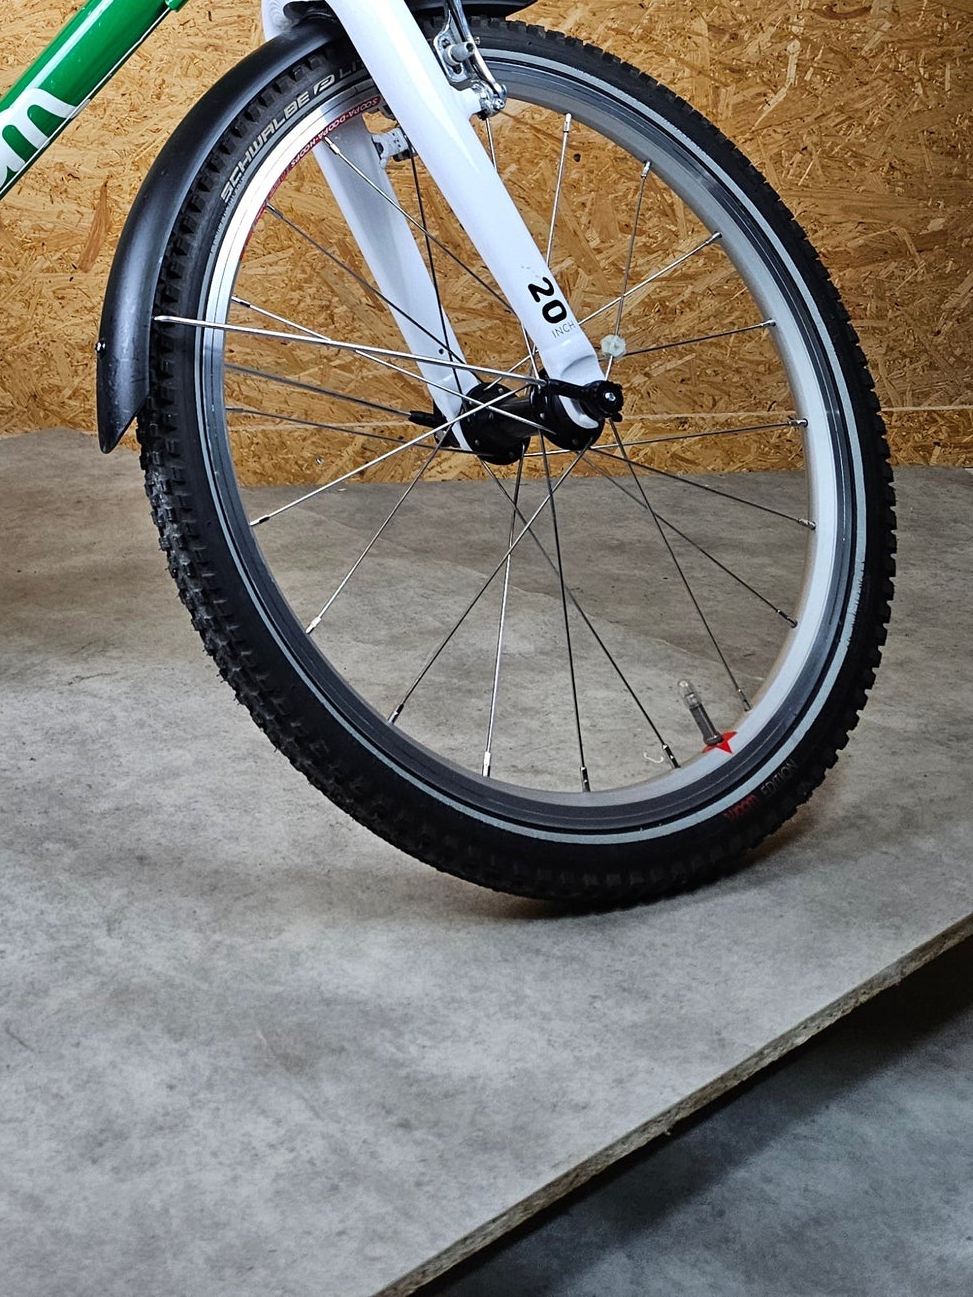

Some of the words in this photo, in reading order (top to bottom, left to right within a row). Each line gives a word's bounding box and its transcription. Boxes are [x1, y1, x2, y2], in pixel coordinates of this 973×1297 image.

[221, 91, 310, 203] SCHWALBE
[528, 276, 567, 324] 20
[551, 320, 576, 339] INCH
[760, 758, 798, 796] EDITION
